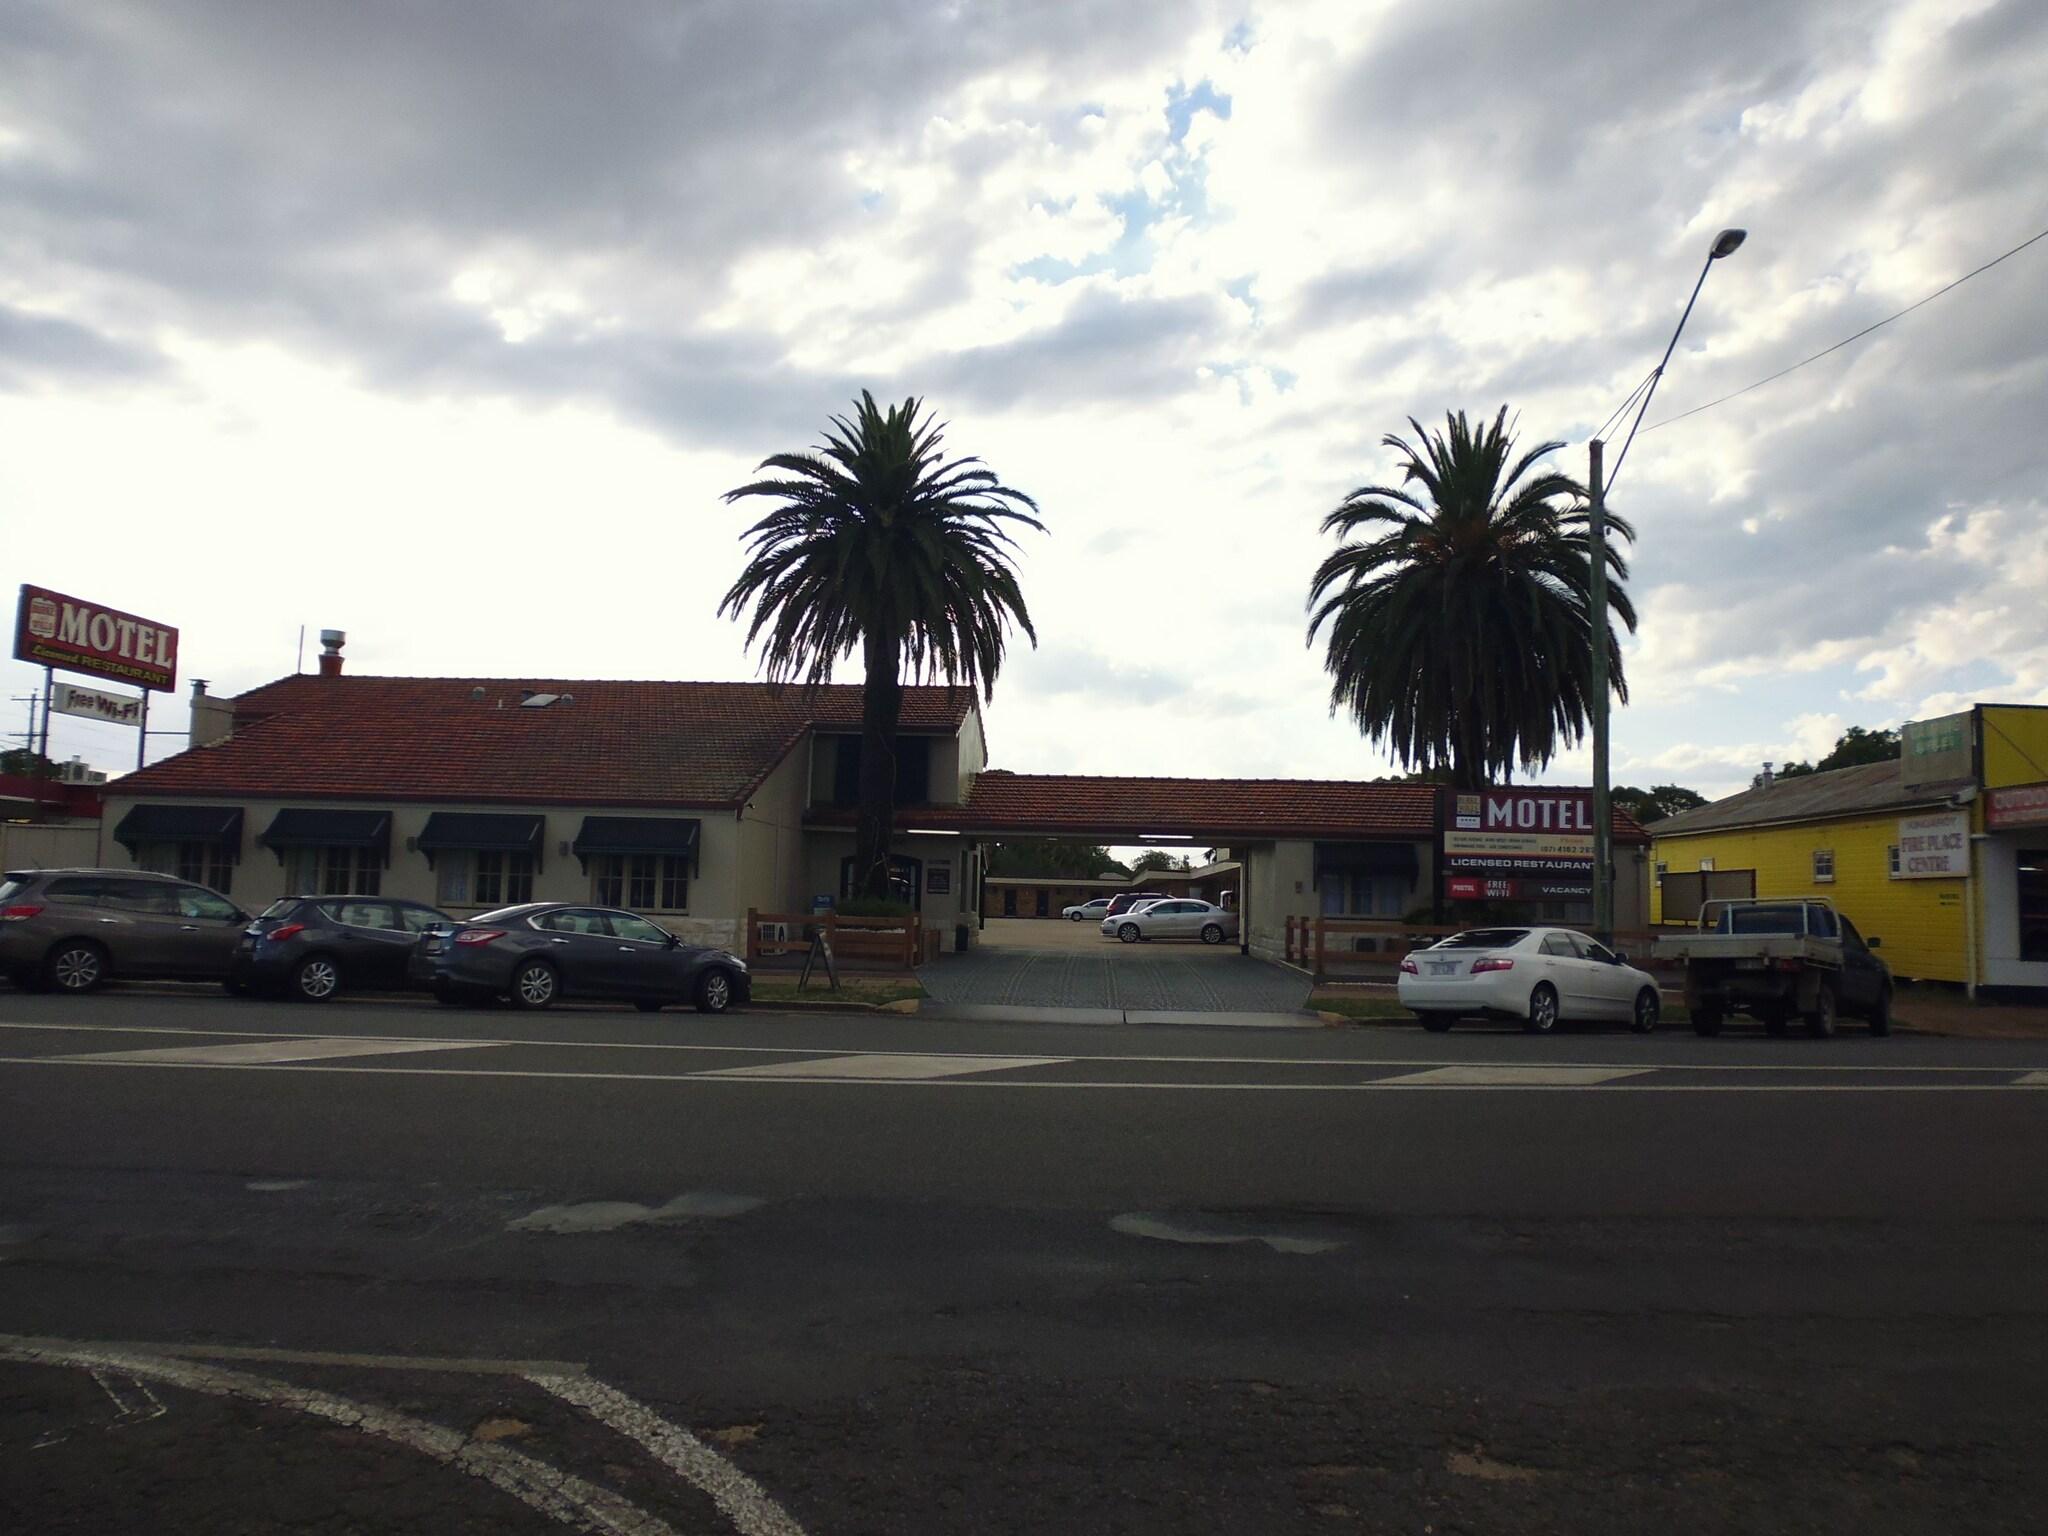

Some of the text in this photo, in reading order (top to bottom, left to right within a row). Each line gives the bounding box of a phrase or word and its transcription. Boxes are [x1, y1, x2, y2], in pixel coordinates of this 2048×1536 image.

[57, 601, 173, 669] MOTEL
[81, 656, 169, 685] RESTAURANT
[66, 689, 95, 710] Free
[1488, 798, 1592, 829] MOTEL
[1902, 832, 1963, 853] FIRE PLACE
[1451, 858, 1513, 868] LICENSED
[1908, 856, 1951, 874] CENTRE
[1487, 880, 1508, 889] FREE
[1541, 886, 1592, 895] VACANCY
